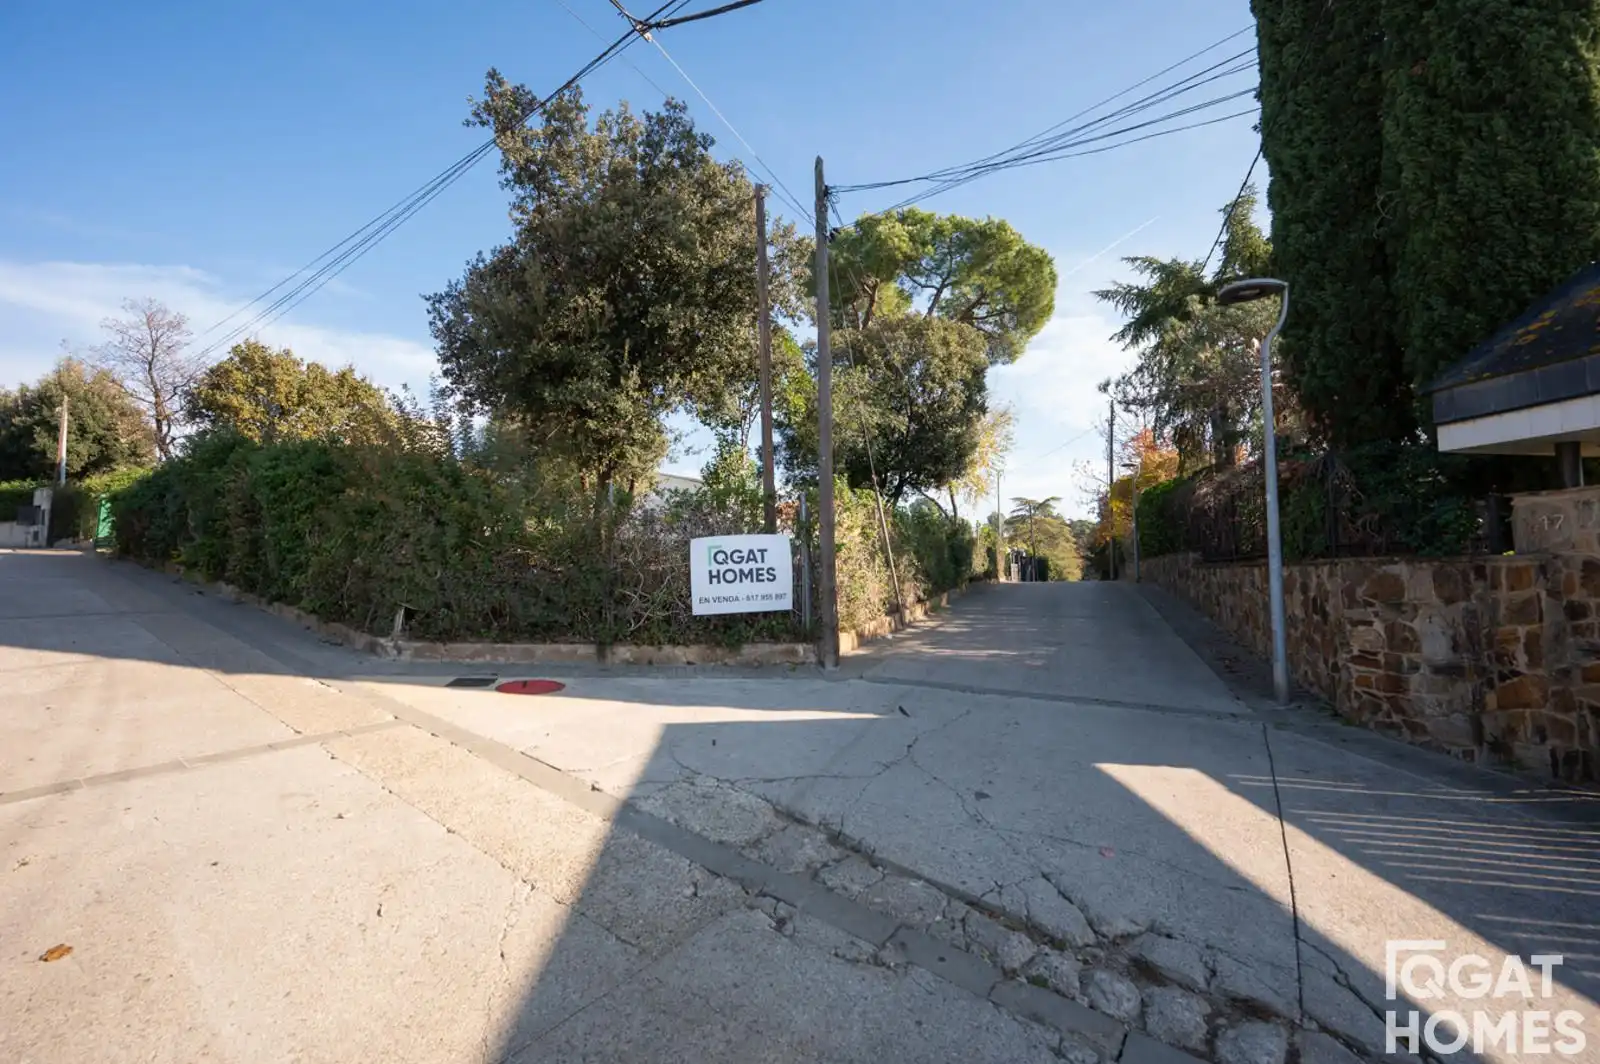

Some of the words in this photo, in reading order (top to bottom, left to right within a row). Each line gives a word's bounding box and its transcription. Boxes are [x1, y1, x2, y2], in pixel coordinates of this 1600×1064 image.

[1539, 514, 1564, 531] 17
[713, 548, 768, 565] QGAT
[708, 567, 777, 585] HOMES
[699, 596, 710, 604] EN
[712, 595, 740, 603] VENDA
